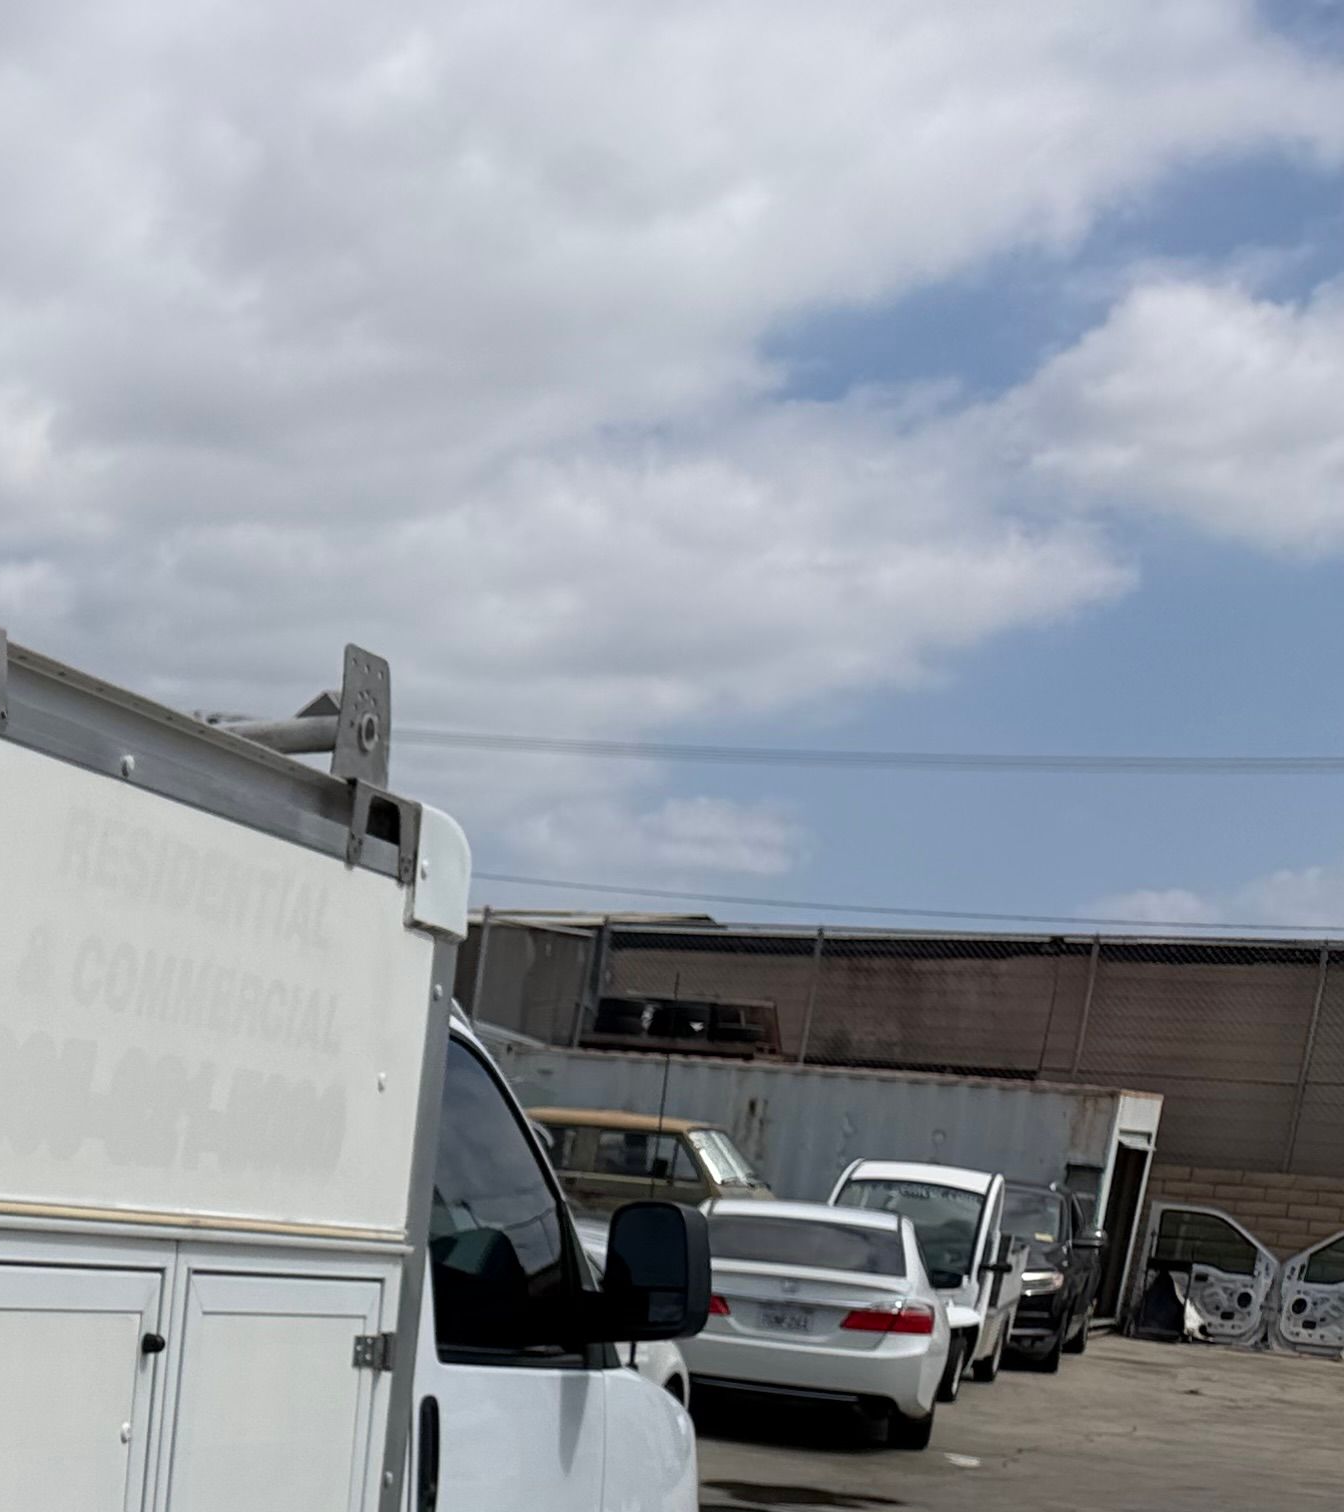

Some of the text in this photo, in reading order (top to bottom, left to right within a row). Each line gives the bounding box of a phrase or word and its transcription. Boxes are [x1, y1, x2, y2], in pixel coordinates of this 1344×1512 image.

[57, 805, 330, 951] RESIDENTIAL
[15, 924, 340, 1055] & COMMERCIAL
